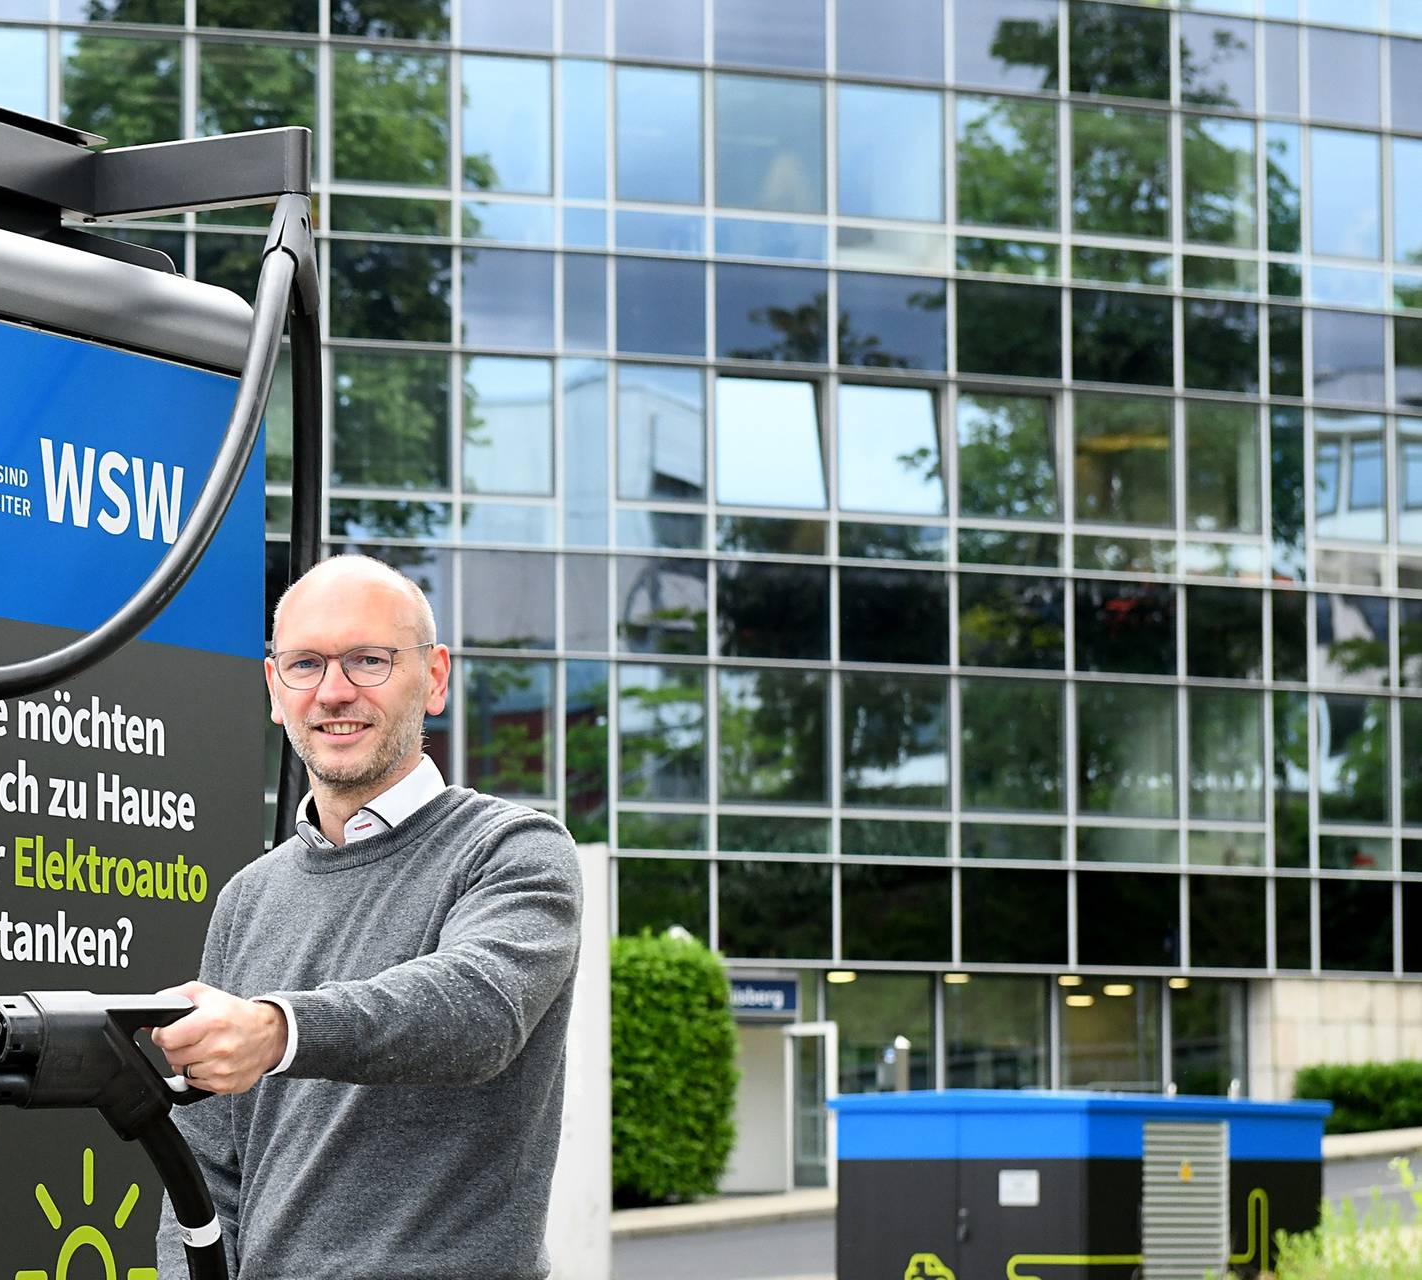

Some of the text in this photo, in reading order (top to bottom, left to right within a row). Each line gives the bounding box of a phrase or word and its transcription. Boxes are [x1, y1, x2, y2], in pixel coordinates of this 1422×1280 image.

[40, 437, 184, 544] WSW
[18, 690, 165, 757] möchten
[48, 778, 87, 820] zu
[97, 772, 196, 832] Hause
[15, 835, 208, 903] Elektroauto
